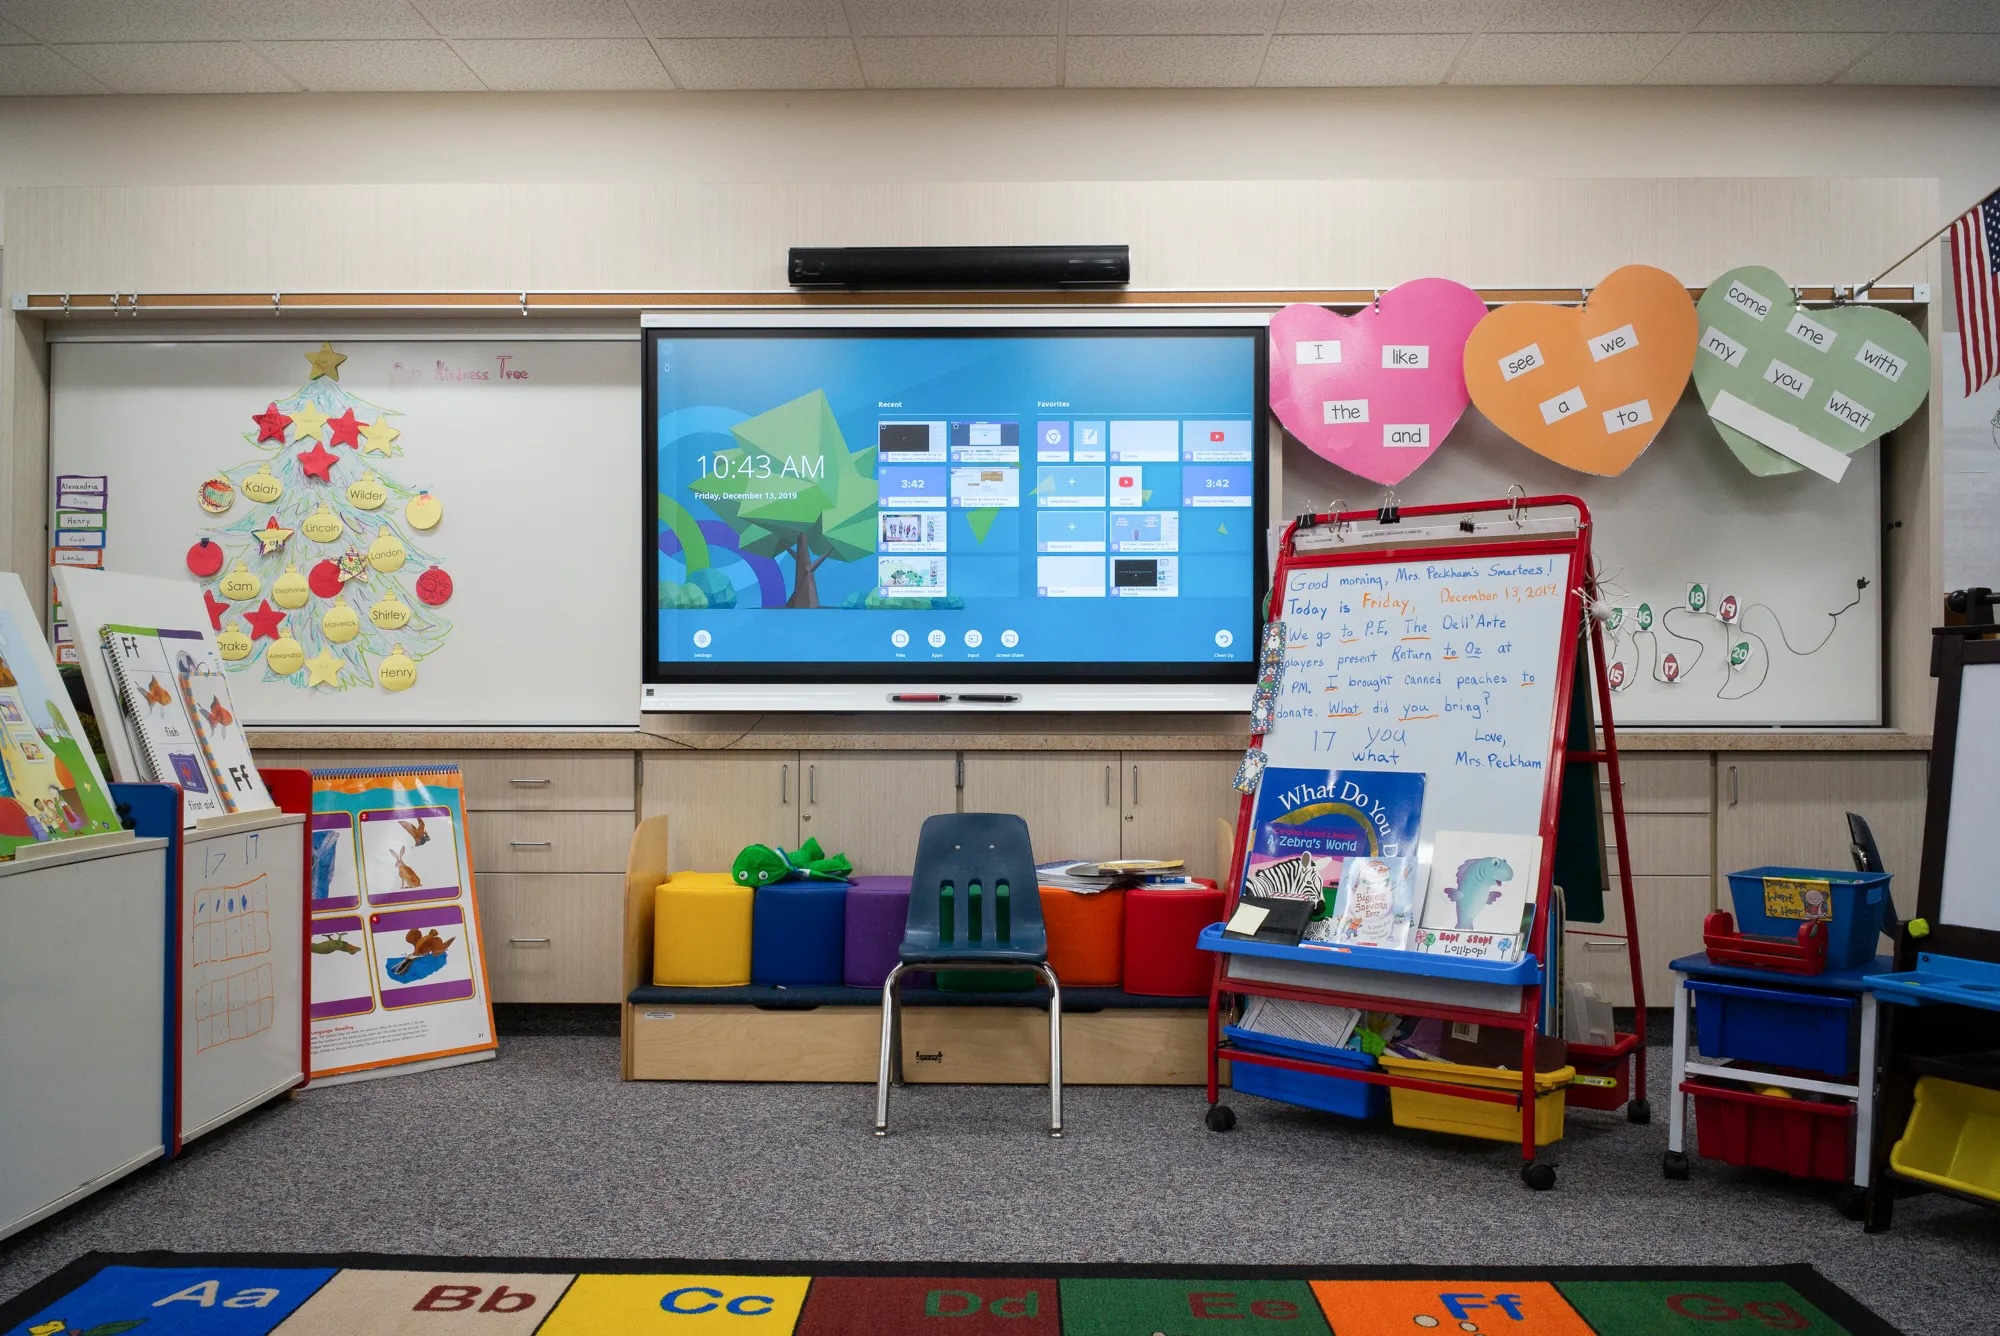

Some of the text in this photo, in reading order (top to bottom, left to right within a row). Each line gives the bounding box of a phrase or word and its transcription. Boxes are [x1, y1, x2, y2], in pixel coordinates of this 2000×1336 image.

[1728, 286, 1768, 317] come
[1797, 322, 1824, 345] me
[1313, 344, 1324, 360] I
[1600, 334, 1627, 353] we
[1708, 336, 1736, 362] my
[1392, 348, 1419, 365] like
[1508, 352, 1537, 374] see
[1864, 348, 1899, 377] with
[435, 360, 489, 381] Kindness
[496, 355, 529, 380] Tree
[1773, 369, 1803, 394] you
[878, 400, 903, 409] Recent
[1037, 400, 1071, 409] Favorites
[1331, 403, 1361, 421] the
[1558, 400, 1570, 414] a
[1829, 396, 1871, 429] what
[1616, 408, 1639, 426] to
[1391, 426, 1421, 444] and
[696, 454, 824, 479] 10:43 AM
[61, 482, 99, 491] Alexandria
[245, 481, 279, 496] Kaiah
[901, 479, 925, 489] 3:42
[1205, 478, 1230, 488] 3:42
[349, 489, 384, 502] Wilder
[694, 492, 798, 501] Friday, December 13, 2019
[67, 516, 91, 527] Henry
[305, 522, 340, 534] Lincoln
[370, 549, 404, 560] Landon
[1290, 558, 1554, 592] Good morning, Mrs. Peckham's Smartees!
[227, 580, 254, 592] Sam
[273, 586, 308, 598] Stephanie
[1288, 598, 1329, 621] Today
[1339, 602, 1351, 614] is
[1362, 592, 1417, 616] Friday,
[1440, 587, 1499, 604] December
[1505, 586, 1521, 605] 13,
[1689, 591, 1705, 605] 18
[372, 609, 408, 623] Shirley
[1638, 611, 1652, 624] 16
[1720, 601, 1735, 617] 19
[323, 619, 358, 630] Maverick
[1288, 614, 1507, 648] We go to P.E. The Dell'Arte
[120, 636, 140, 659] Ff
[268, 651, 303, 661] Alexandria
[1732, 646, 1749, 660] 20
[1281, 641, 1513, 679] players present Return to Oz at
[1664, 662, 1678, 676] 17
[380, 667, 414, 680] Henry
[1609, 669, 1623, 683] 15
[1291, 681, 1312, 696] PM.
[1328, 674, 1339, 689] I
[1348, 674, 1394, 694] brought
[1404, 671, 1442, 686] canned
[1456, 671, 1509, 696] peaches
[1521, 670, 1536, 685] to
[1277, 690, 1492, 721] donate. What did you bring?
[164, 726, 180, 738] fish
[1312, 730, 1338, 752] 17
[1474, 727, 1508, 748] Love,
[1351, 748, 1401, 766] what
[1454, 751, 1543, 771] Mrs. Peckham
[228, 764, 253, 792] Ff
[188, 799, 216, 812] first aid
[1278, 782, 1337, 812] What
[1339, 781, 1370, 808] Do
[1368, 799, 1392, 838] You
[244, 833, 260, 865] 17
[1267, 835, 1358, 853] A Zebra's World
[203, 845, 228, 880] 17
[1356, 893, 1386, 905] Biggest
[1767, 891, 1795, 905] Want
[1355, 902, 1388, 914] Snowman
[1365, 909, 1381, 918] Ever
[1768, 906, 1803, 917] to Hear
[1438, 931, 1494, 947] Hop! Stop!
[1444, 944, 1488, 958] Lollipop!
[151, 1279, 282, 1309] Aa
[411, 1284, 538, 1316] Bb
[659, 1286, 777, 1317] Cc
[924, 1289, 1040, 1320] Dd
[1187, 1292, 1300, 1321] Ee
[1438, 1292, 1530, 1323] Ff
[1666, 1292, 1814, 1331] Gg
